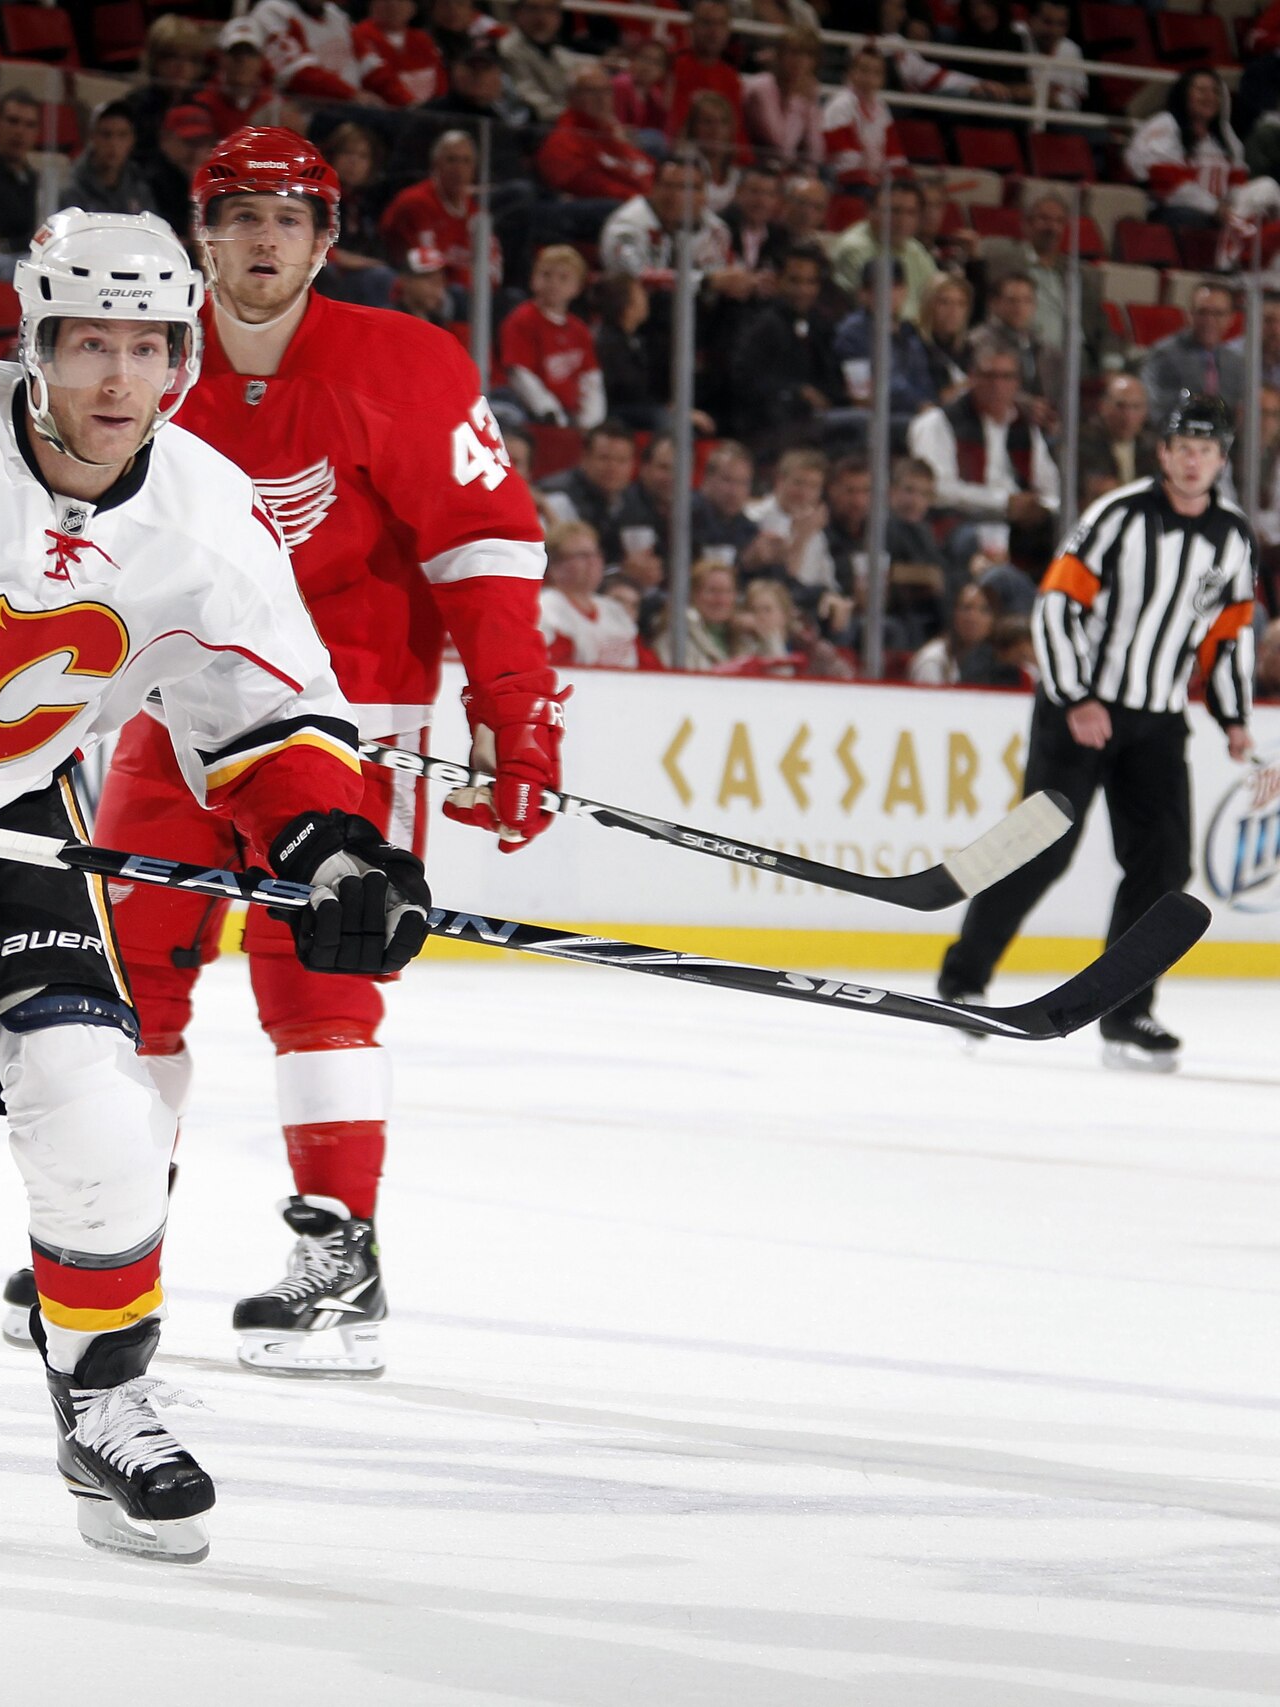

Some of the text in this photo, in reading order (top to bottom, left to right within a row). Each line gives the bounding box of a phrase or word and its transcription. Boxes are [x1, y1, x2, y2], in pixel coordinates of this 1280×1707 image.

[246, 160, 289, 170] Reebok
[451, 395, 511, 491] 43
[661, 716, 1025, 818] CAESARS
[516, 783, 530, 823] Reebok
[279, 822, 315, 862] BAUER
[776, 972, 888, 1005] S19
